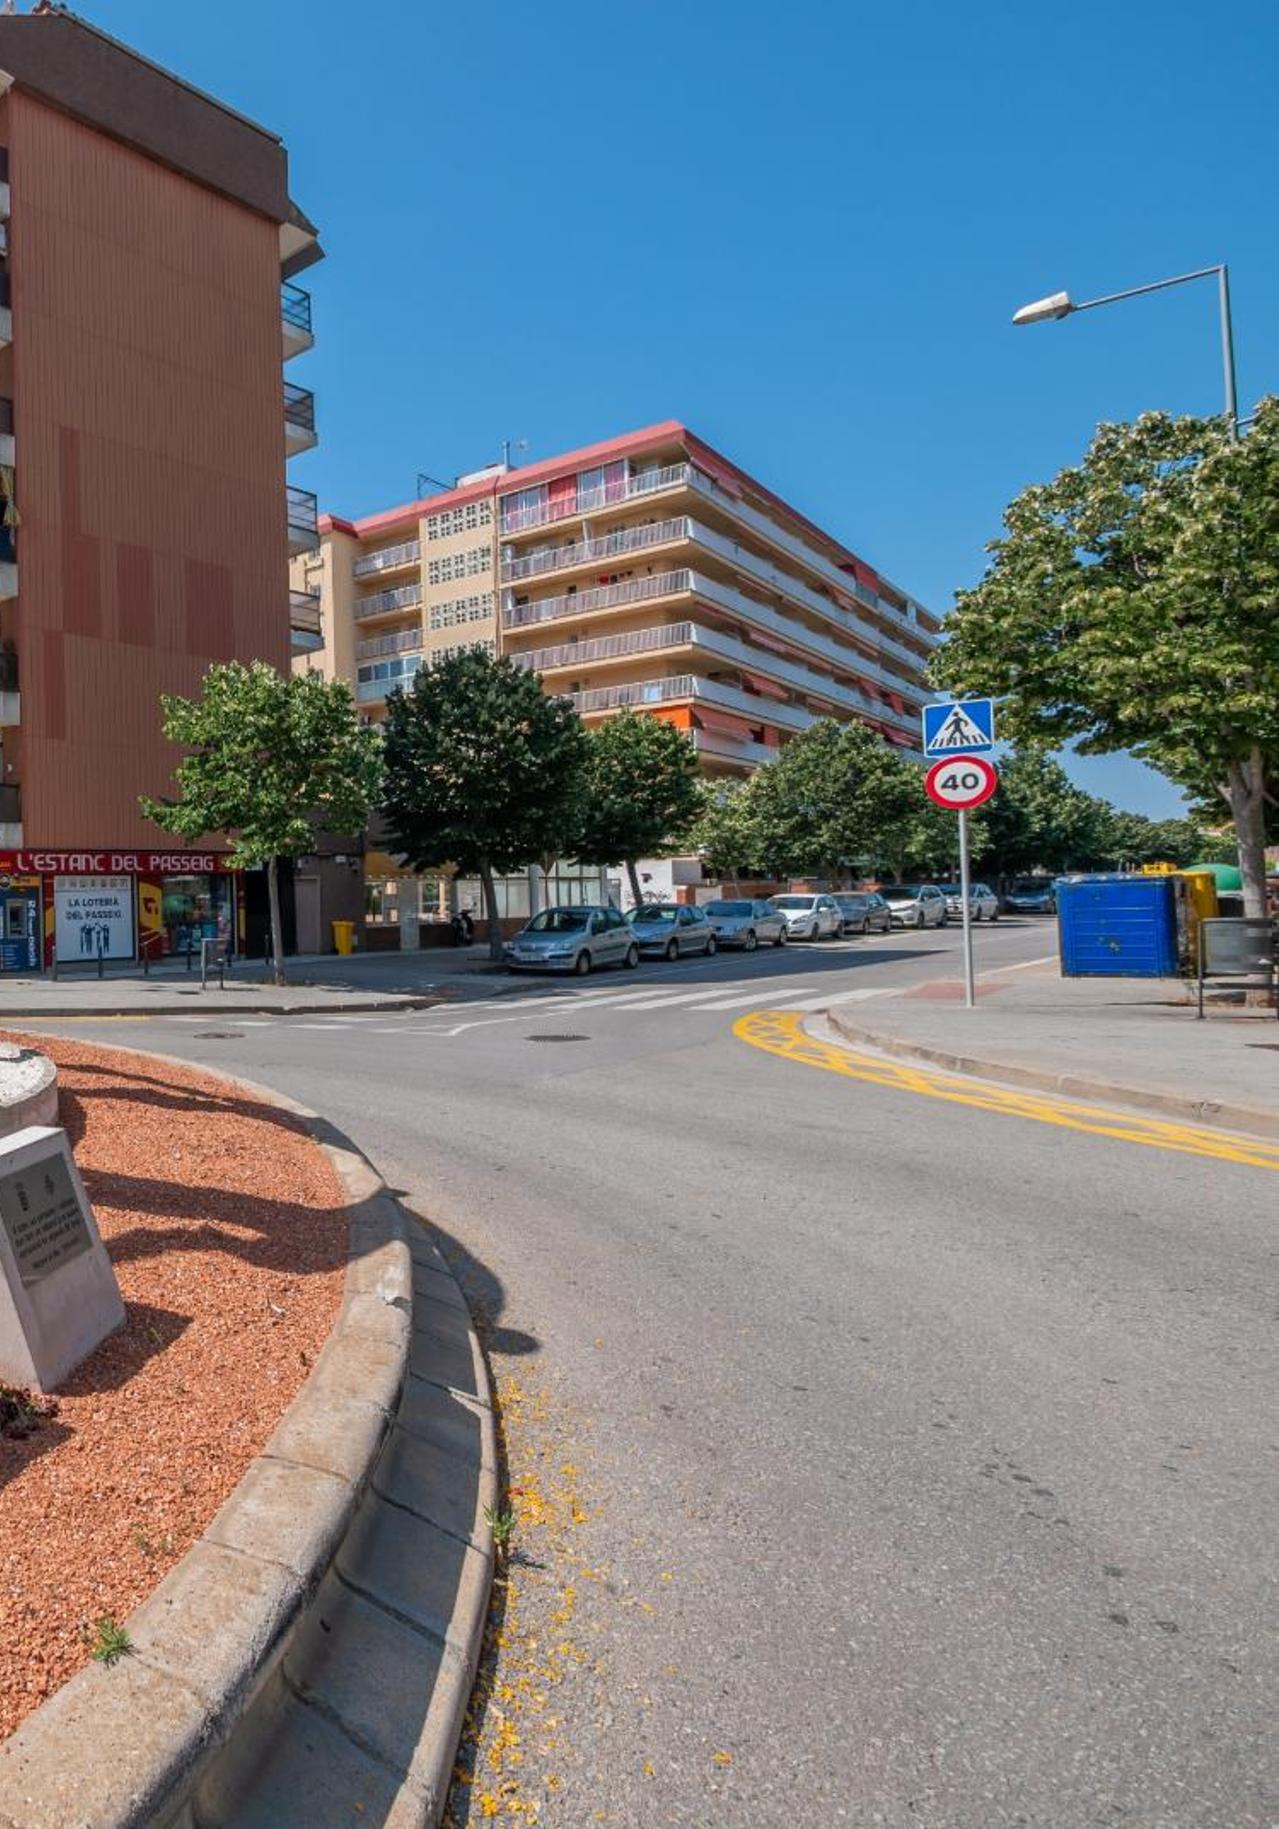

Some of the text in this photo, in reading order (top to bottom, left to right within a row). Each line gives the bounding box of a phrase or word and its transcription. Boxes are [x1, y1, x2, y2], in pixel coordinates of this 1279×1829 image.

[941, 773, 979, 791] 40
[17, 852, 106, 872] L'ESTANC
[111, 854, 144, 872] DEL
[150, 855, 214, 871] PASSEIG
